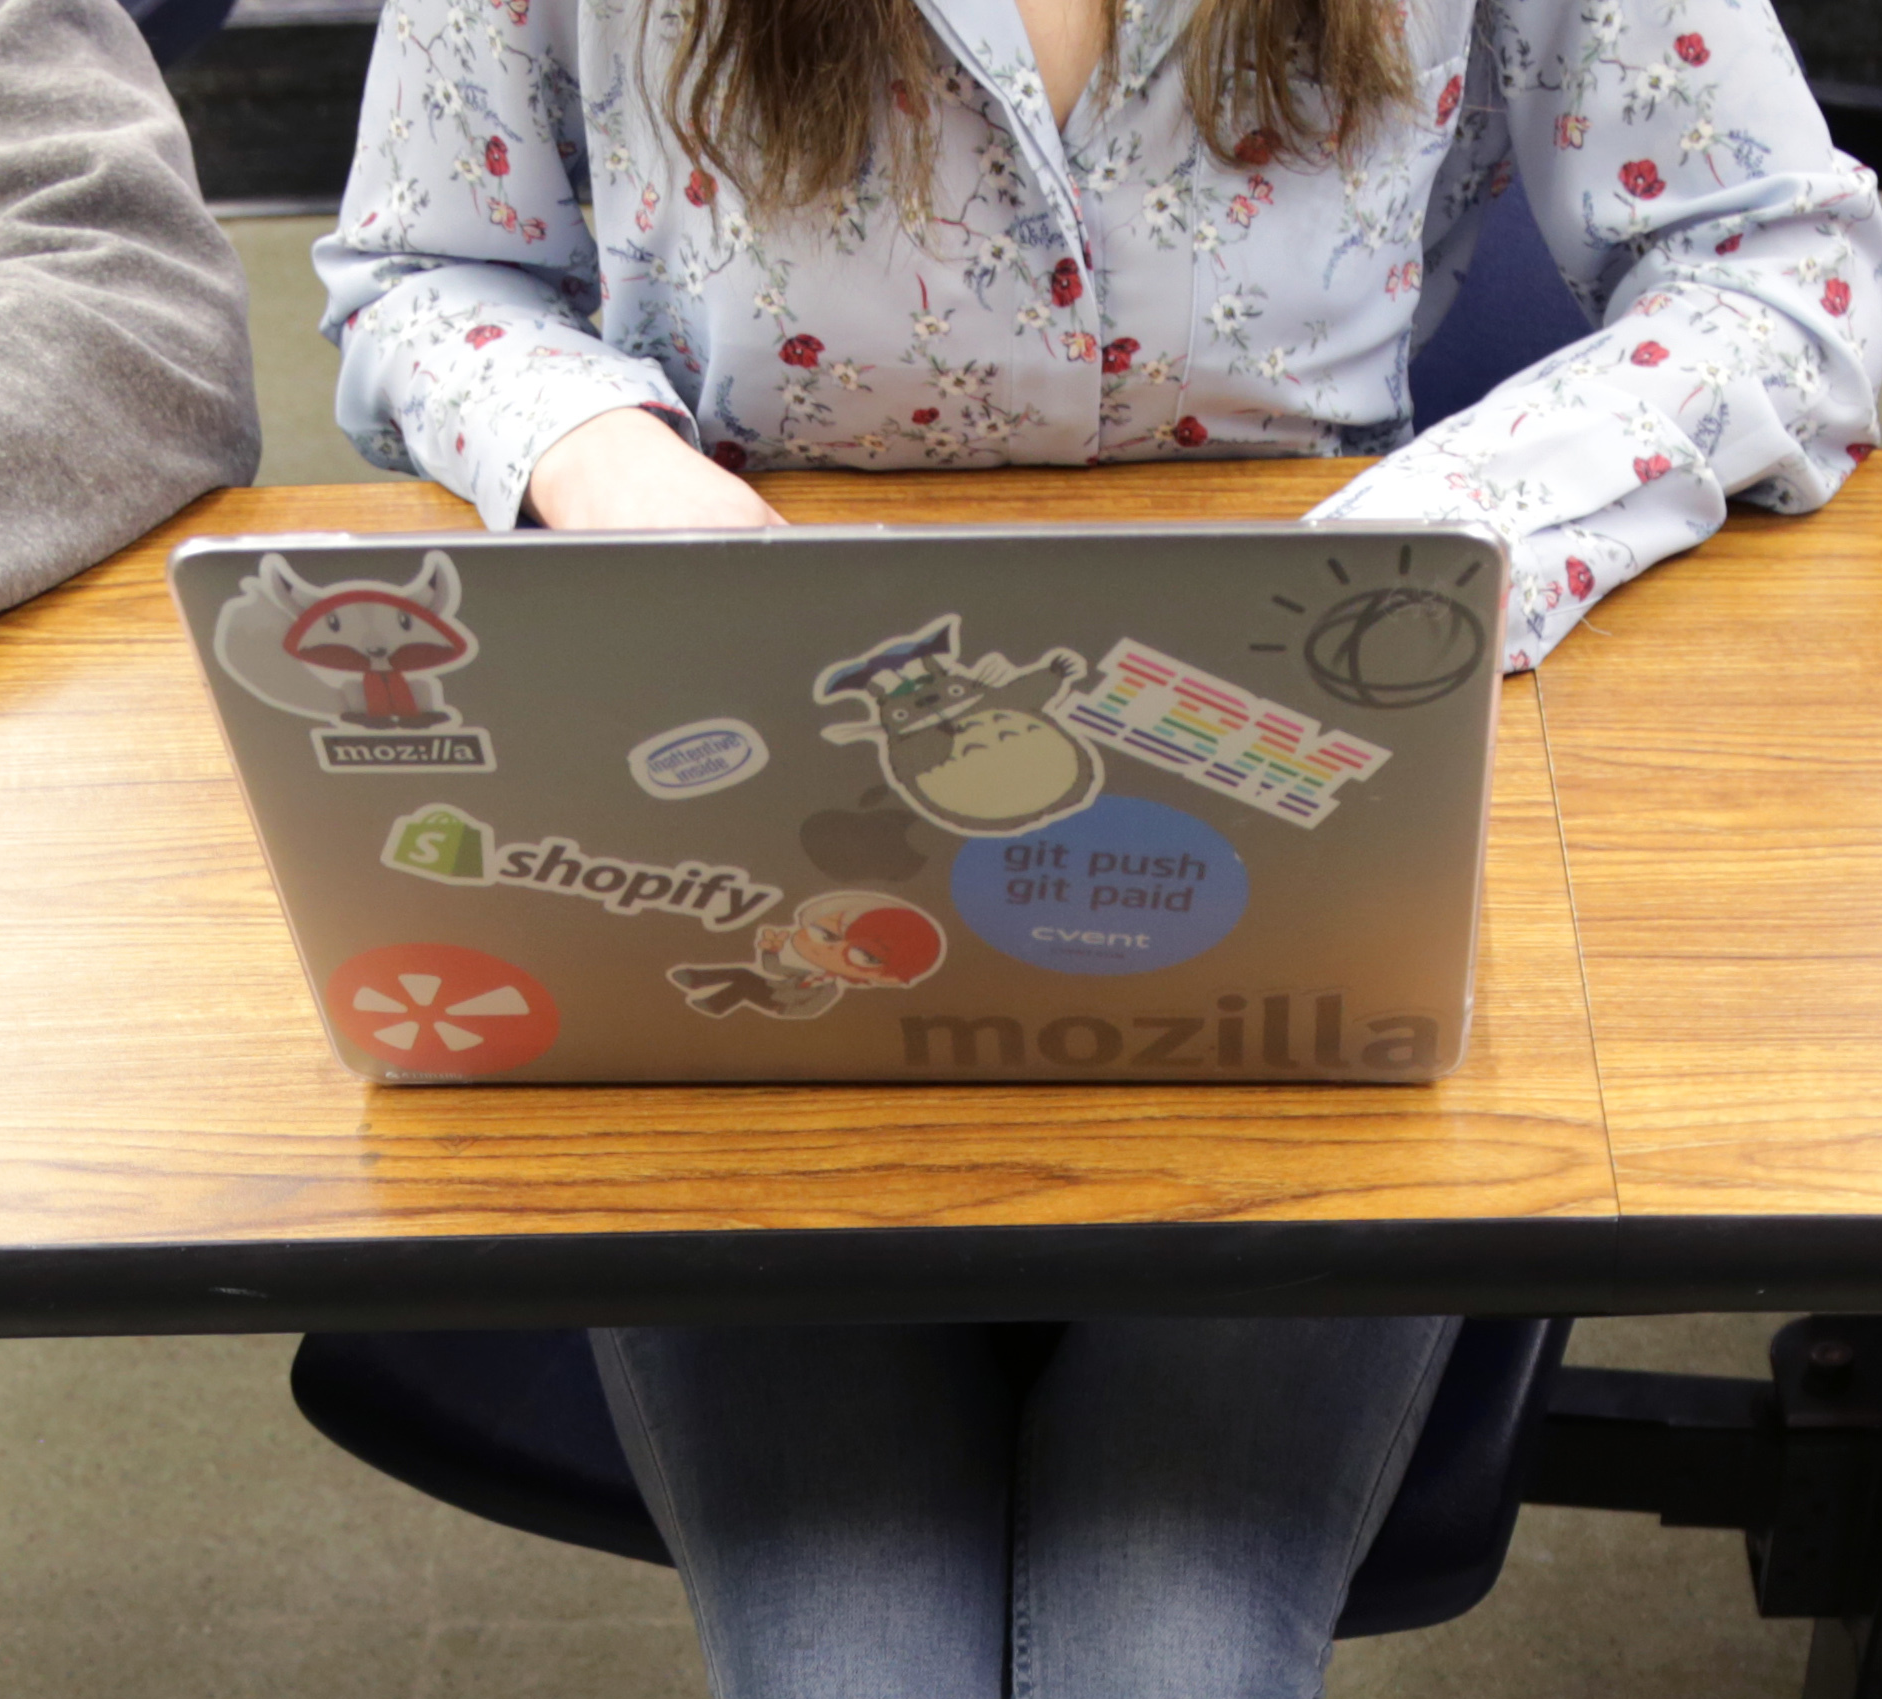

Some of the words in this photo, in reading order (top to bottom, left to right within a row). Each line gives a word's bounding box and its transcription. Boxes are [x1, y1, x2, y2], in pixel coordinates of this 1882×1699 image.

[1003, 840, 1071, 874] git
[1087, 848, 1208, 883] push
[499, 845, 778, 925] shopify
[1005, 873, 1073, 908] git
[1089, 879, 1194, 913] paid
[1031, 926, 1151, 951] cvent
[900, 993, 1446, 1072] mozilla
